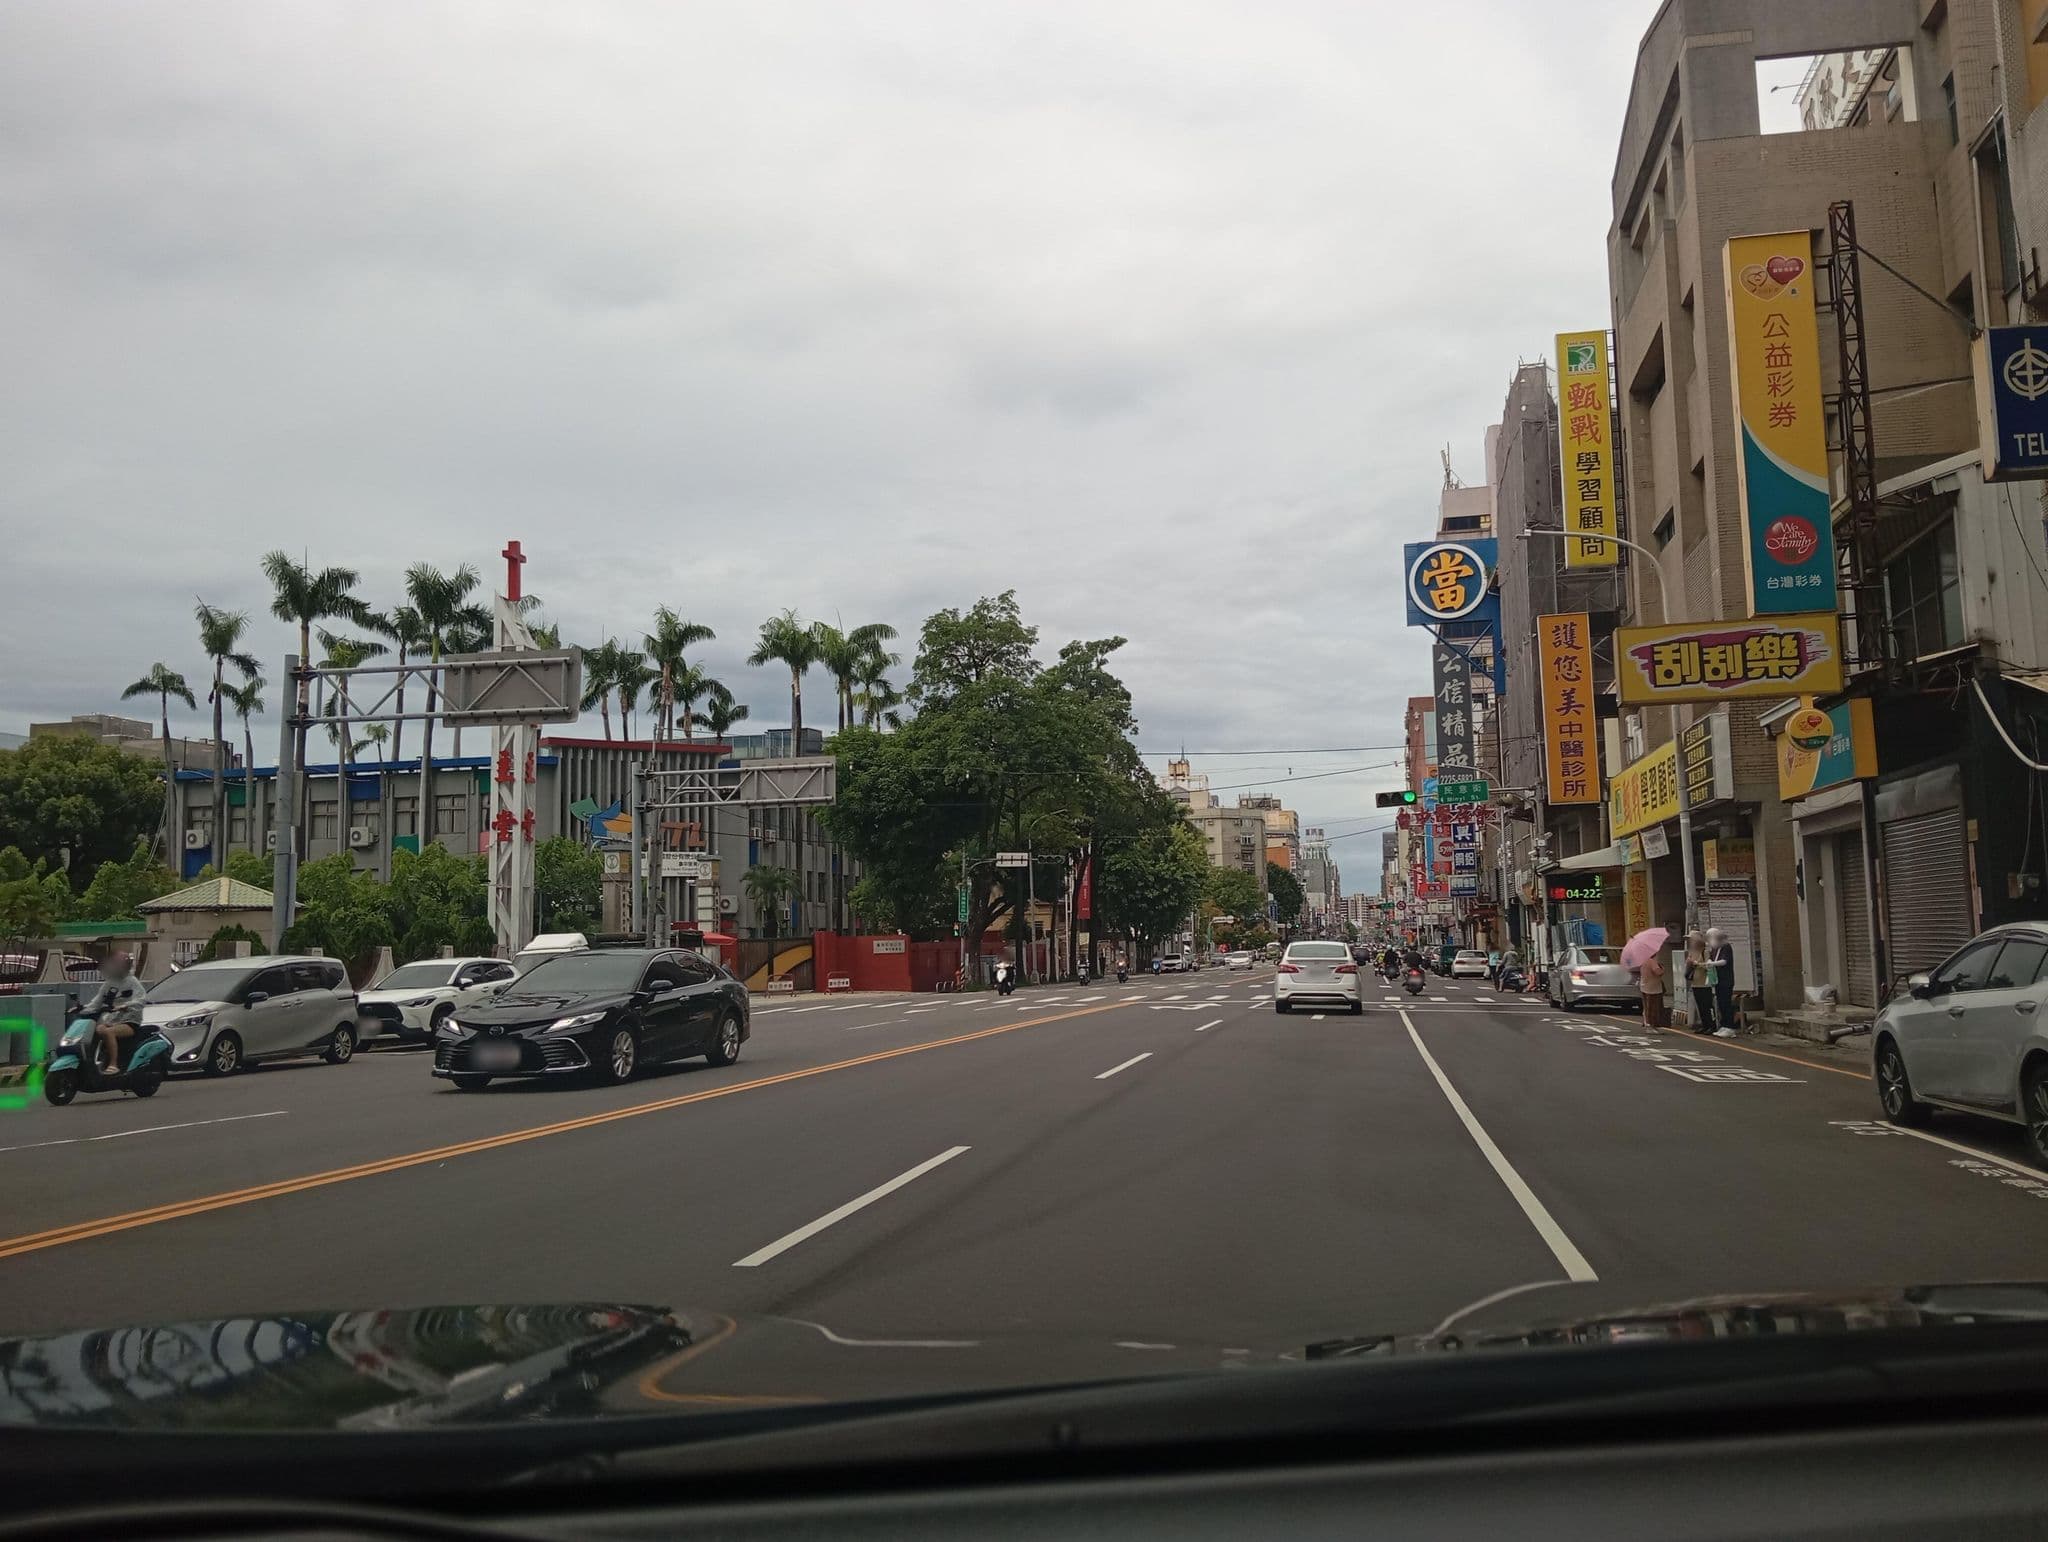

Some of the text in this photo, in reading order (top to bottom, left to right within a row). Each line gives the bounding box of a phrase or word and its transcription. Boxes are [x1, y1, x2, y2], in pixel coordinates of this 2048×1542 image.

[1761, 313, 1797, 429] 公益彩券
[2013, 432, 2048, 457] TEL
[1422, 552, 1475, 612] 當
[1766, 574, 1822, 590] 台灣彩券
[1653, 631, 1801, 687] 刮刮樂
[1436, 653, 1467, 768] 公信精品
[1551, 621, 1586, 798] 護您美中醫診所
